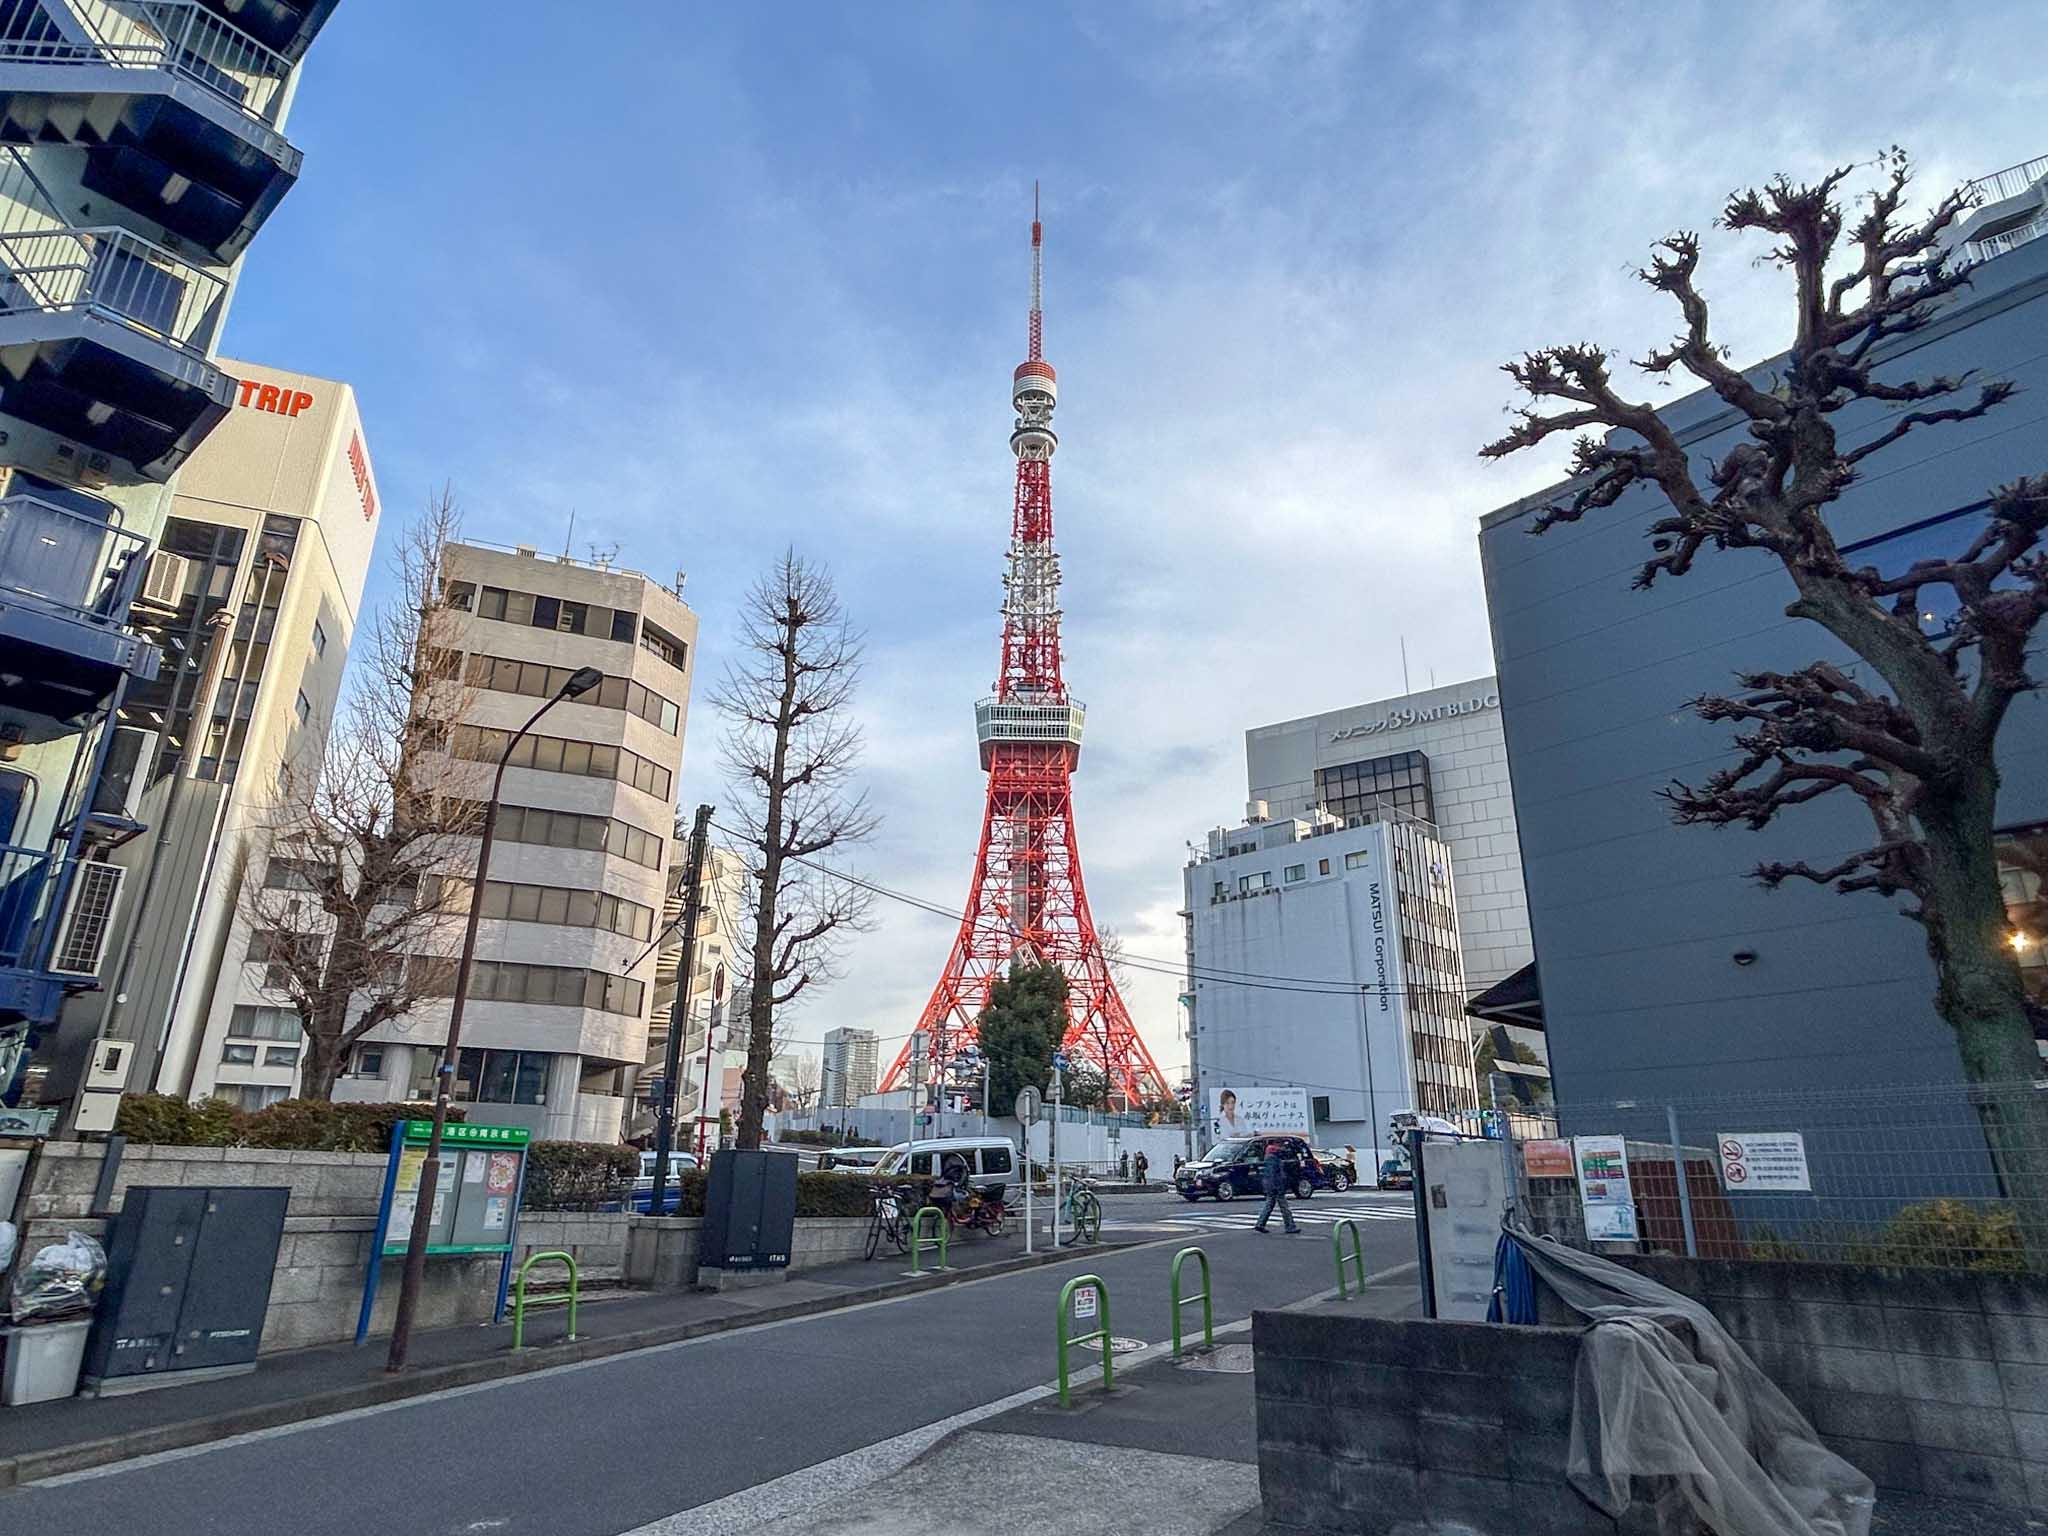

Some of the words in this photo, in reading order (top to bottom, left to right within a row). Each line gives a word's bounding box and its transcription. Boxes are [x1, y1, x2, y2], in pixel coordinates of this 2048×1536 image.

[239, 380, 313, 417] TRIP
[1369, 882, 1384, 934] MATSUI
[1374, 937, 1389, 1012] Corporation
